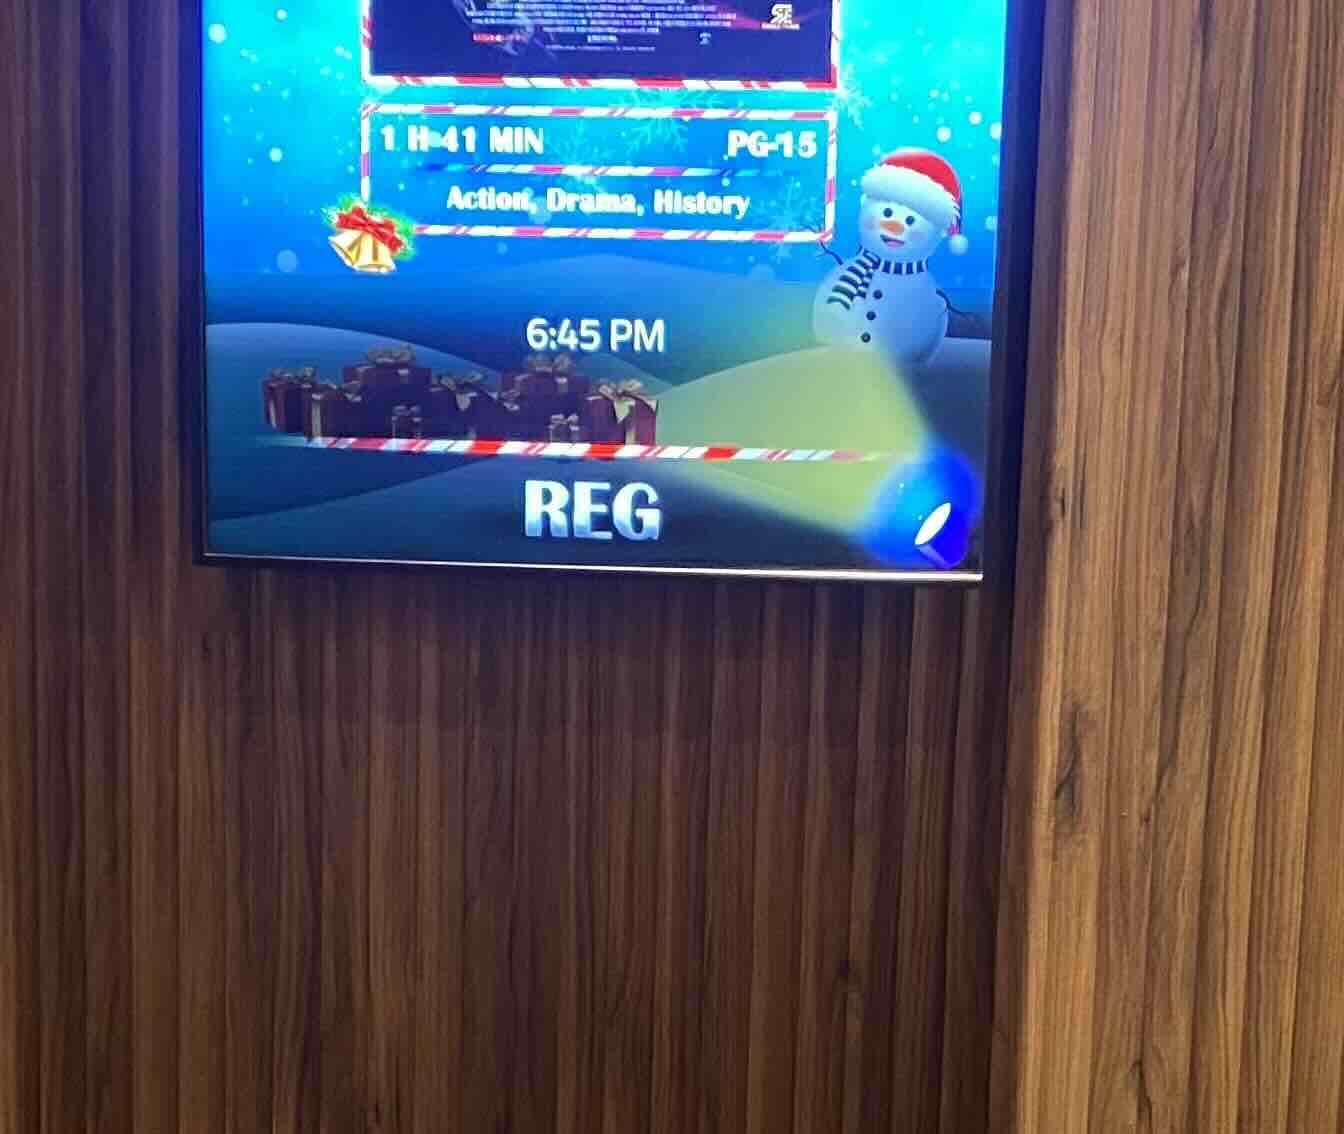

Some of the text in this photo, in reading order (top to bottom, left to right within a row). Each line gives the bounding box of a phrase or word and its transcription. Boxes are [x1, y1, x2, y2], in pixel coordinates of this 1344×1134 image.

[380, 124, 395, 151] 1
[489, 126, 544, 154] MIN
[727, 129, 817, 158] PG-15
[447, 185, 751, 219] Action, Drama, History
[526, 317, 665, 352] 6:45 PM
[524, 479, 662, 541] REG
